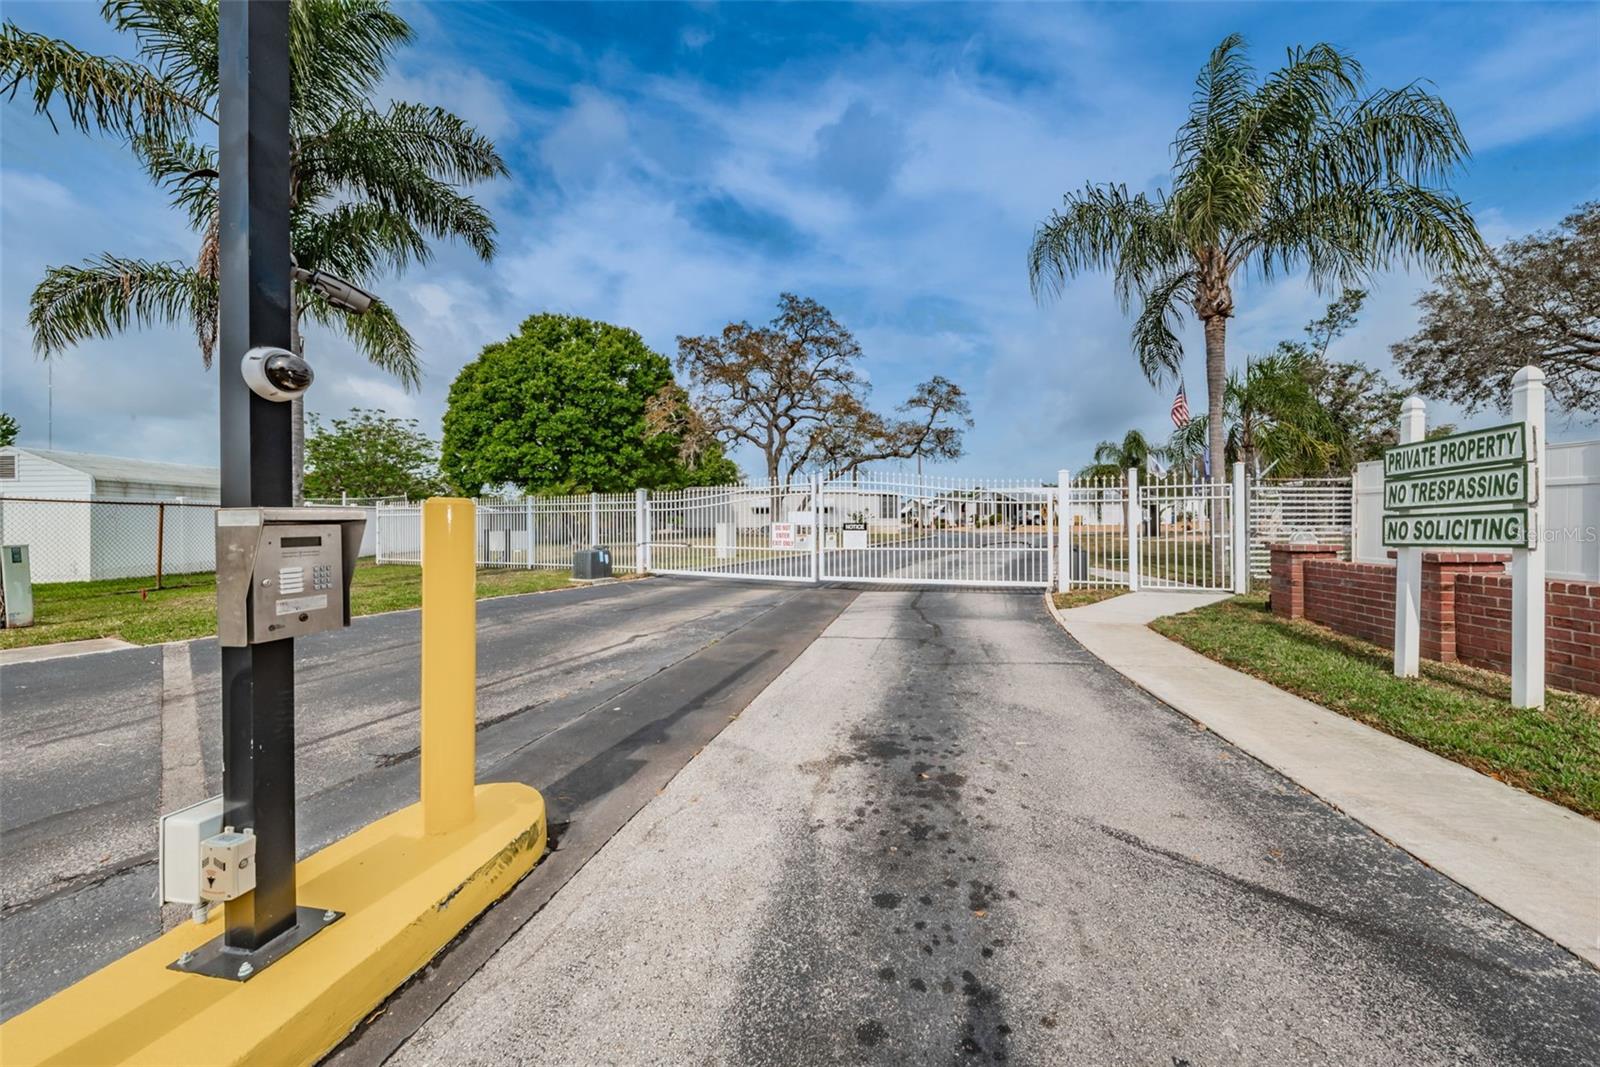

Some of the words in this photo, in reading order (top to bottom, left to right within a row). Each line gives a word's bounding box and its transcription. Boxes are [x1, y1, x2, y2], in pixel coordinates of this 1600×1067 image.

[1388, 446, 1436, 472] PRIVATE
[1440, 431, 1518, 464] PROPERTY
[1389, 486, 1407, 504] NO
[1411, 472, 1519, 502] TRESPASSING
[1387, 521, 1409, 540] NO
[1413, 517, 1519, 540] SOLICITING
